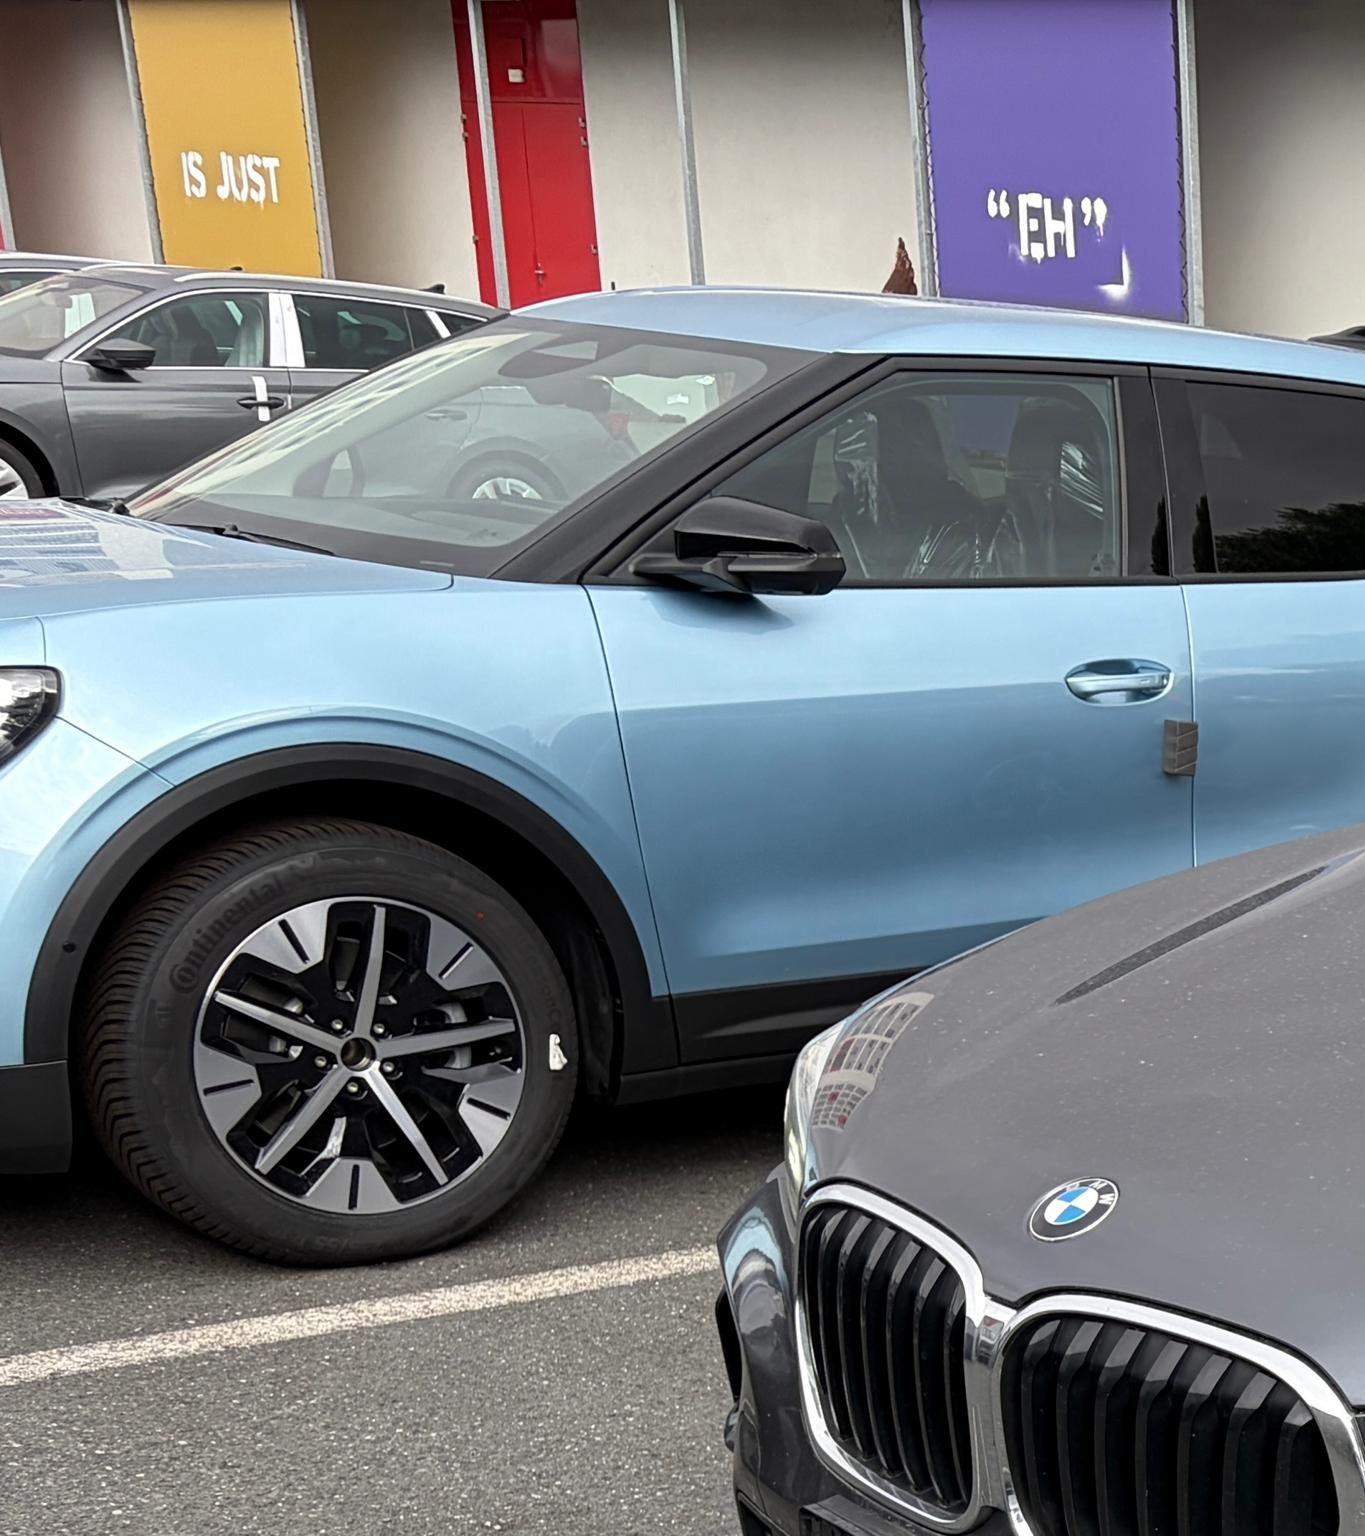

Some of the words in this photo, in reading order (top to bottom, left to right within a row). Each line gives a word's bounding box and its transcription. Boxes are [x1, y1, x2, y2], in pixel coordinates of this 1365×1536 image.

[180, 151, 207, 198] IS
[216, 151, 280, 207] JUST
[168, 874, 287, 993] Continental
